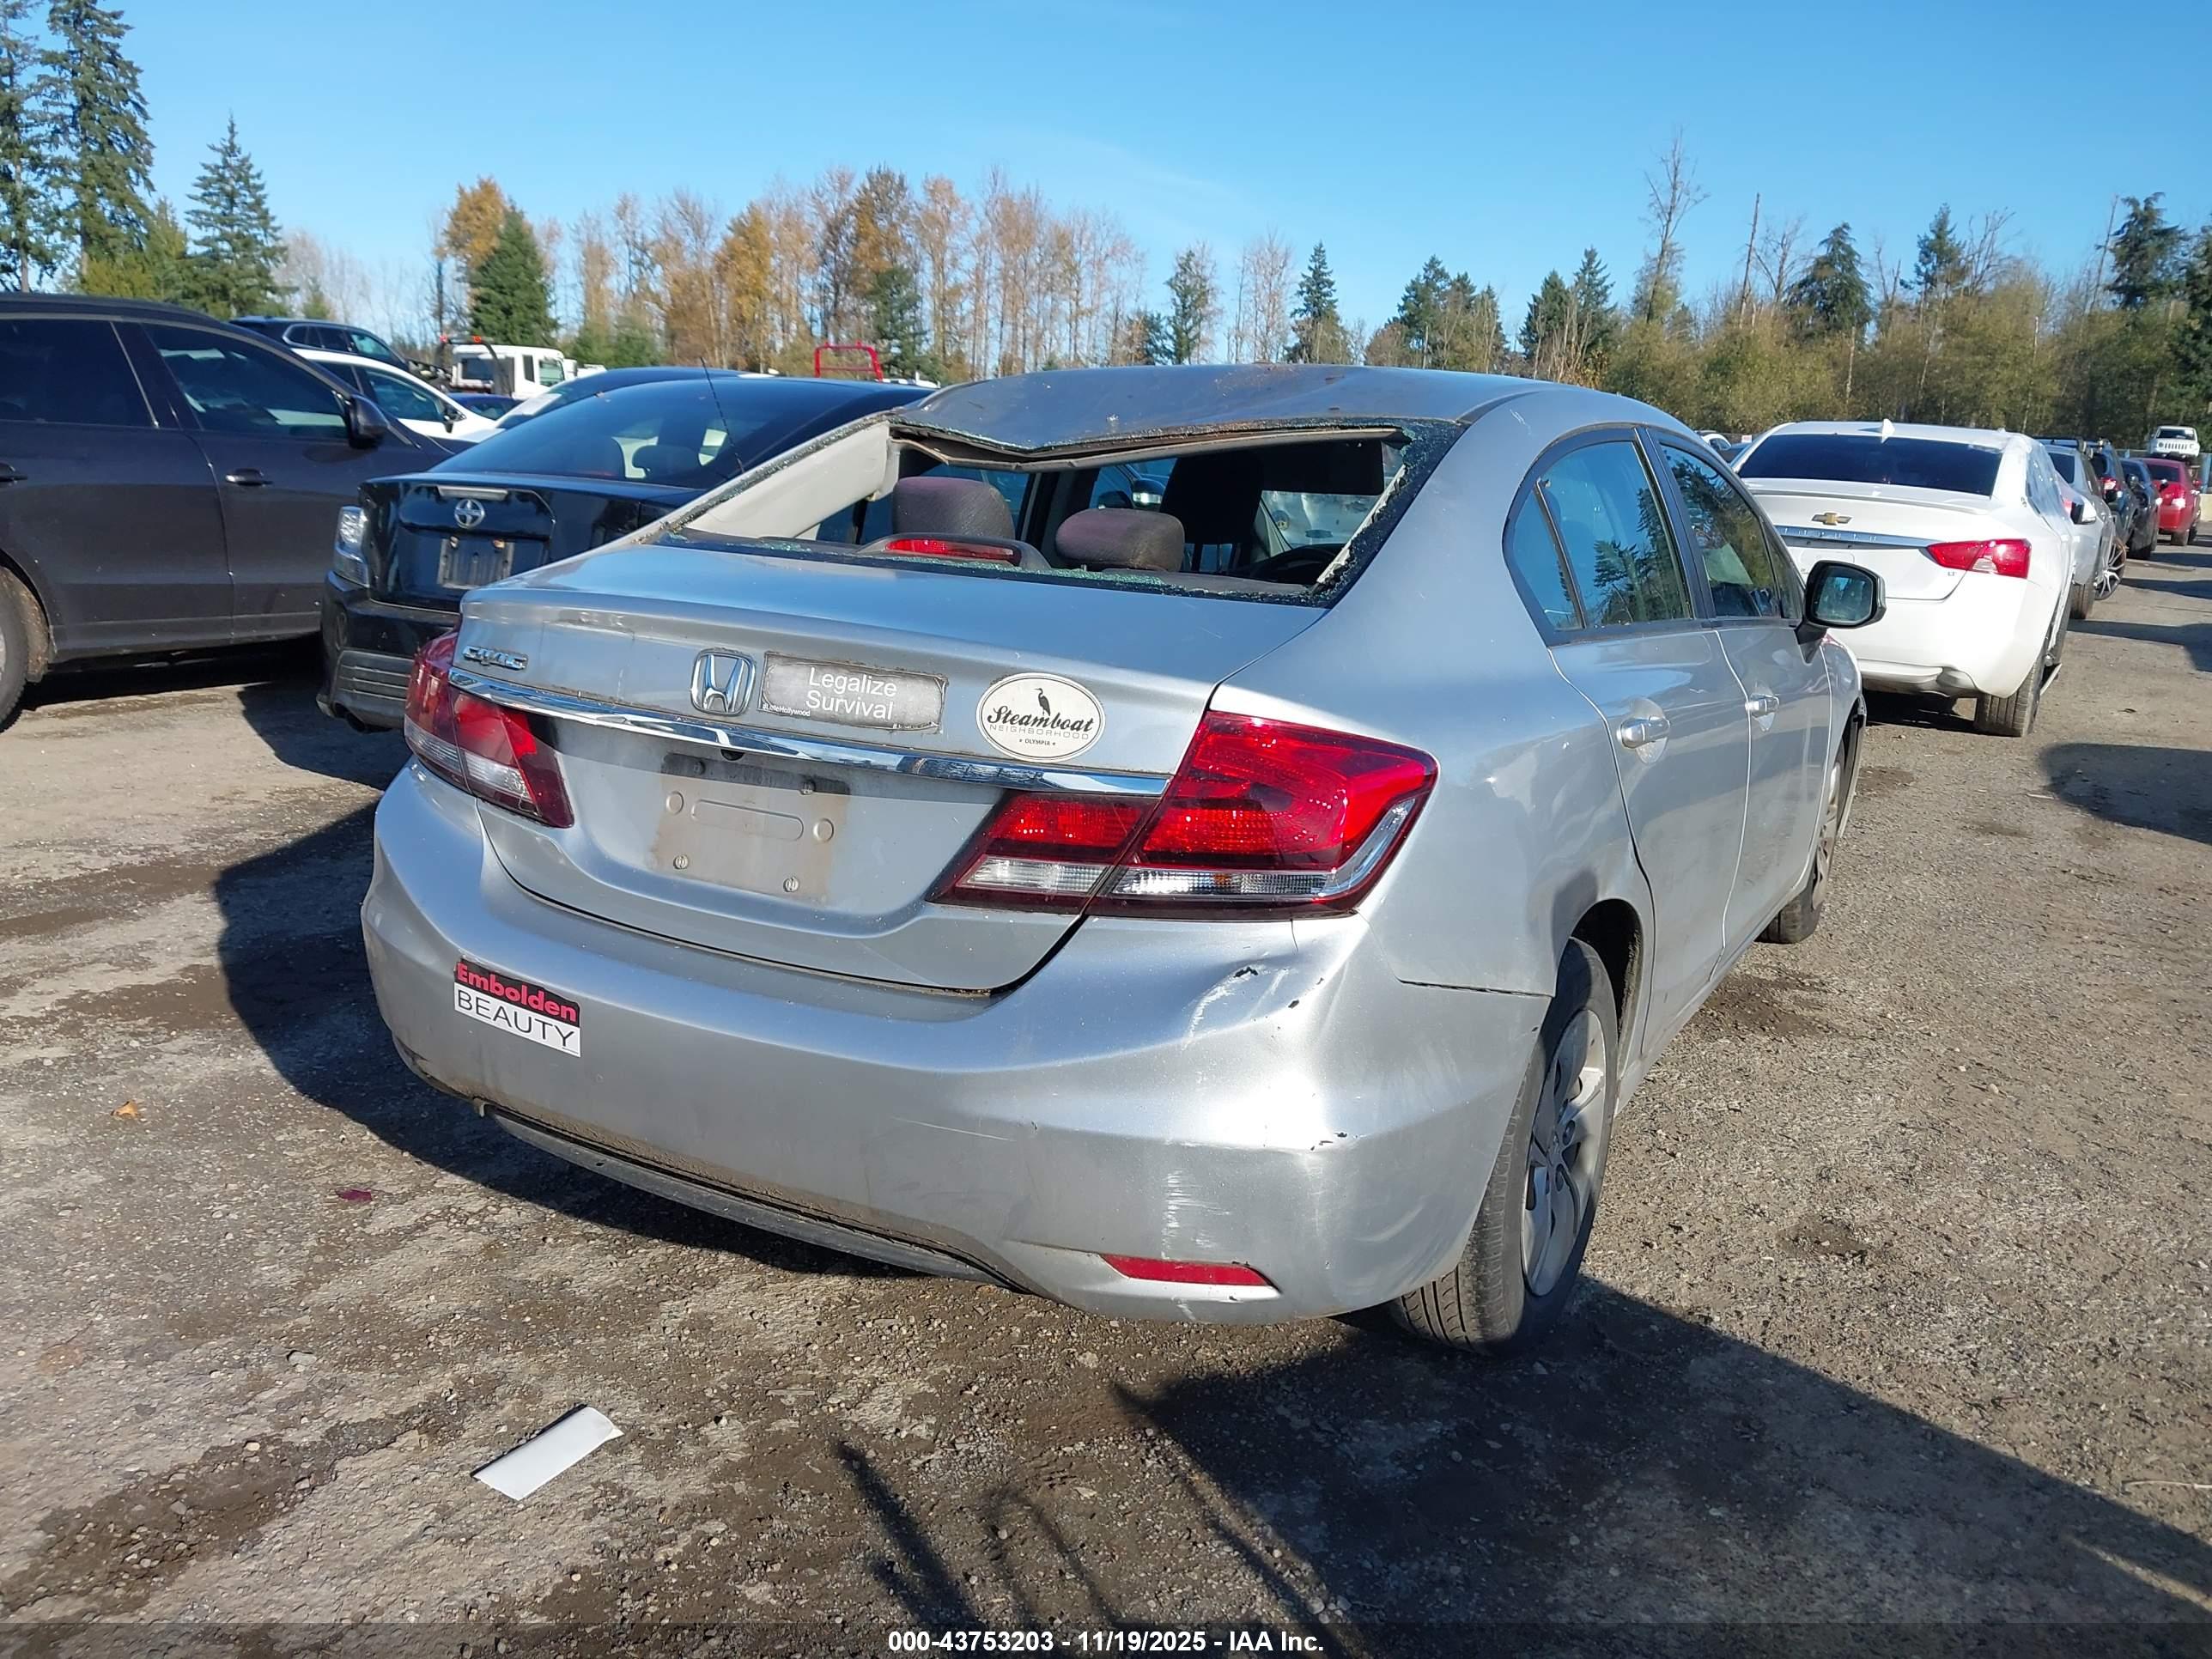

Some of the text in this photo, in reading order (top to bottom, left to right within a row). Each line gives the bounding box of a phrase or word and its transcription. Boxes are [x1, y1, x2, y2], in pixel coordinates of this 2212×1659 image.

[808, 666, 898, 697] Legalize
[805, 690, 894, 720] Survival
[987, 705, 1094, 732] Steamboat
[989, 724, 1089, 740] NEIGHBORHOOD
[456, 961, 578, 1023] Embolden
[457, 989, 575, 1047] BEAUTY
